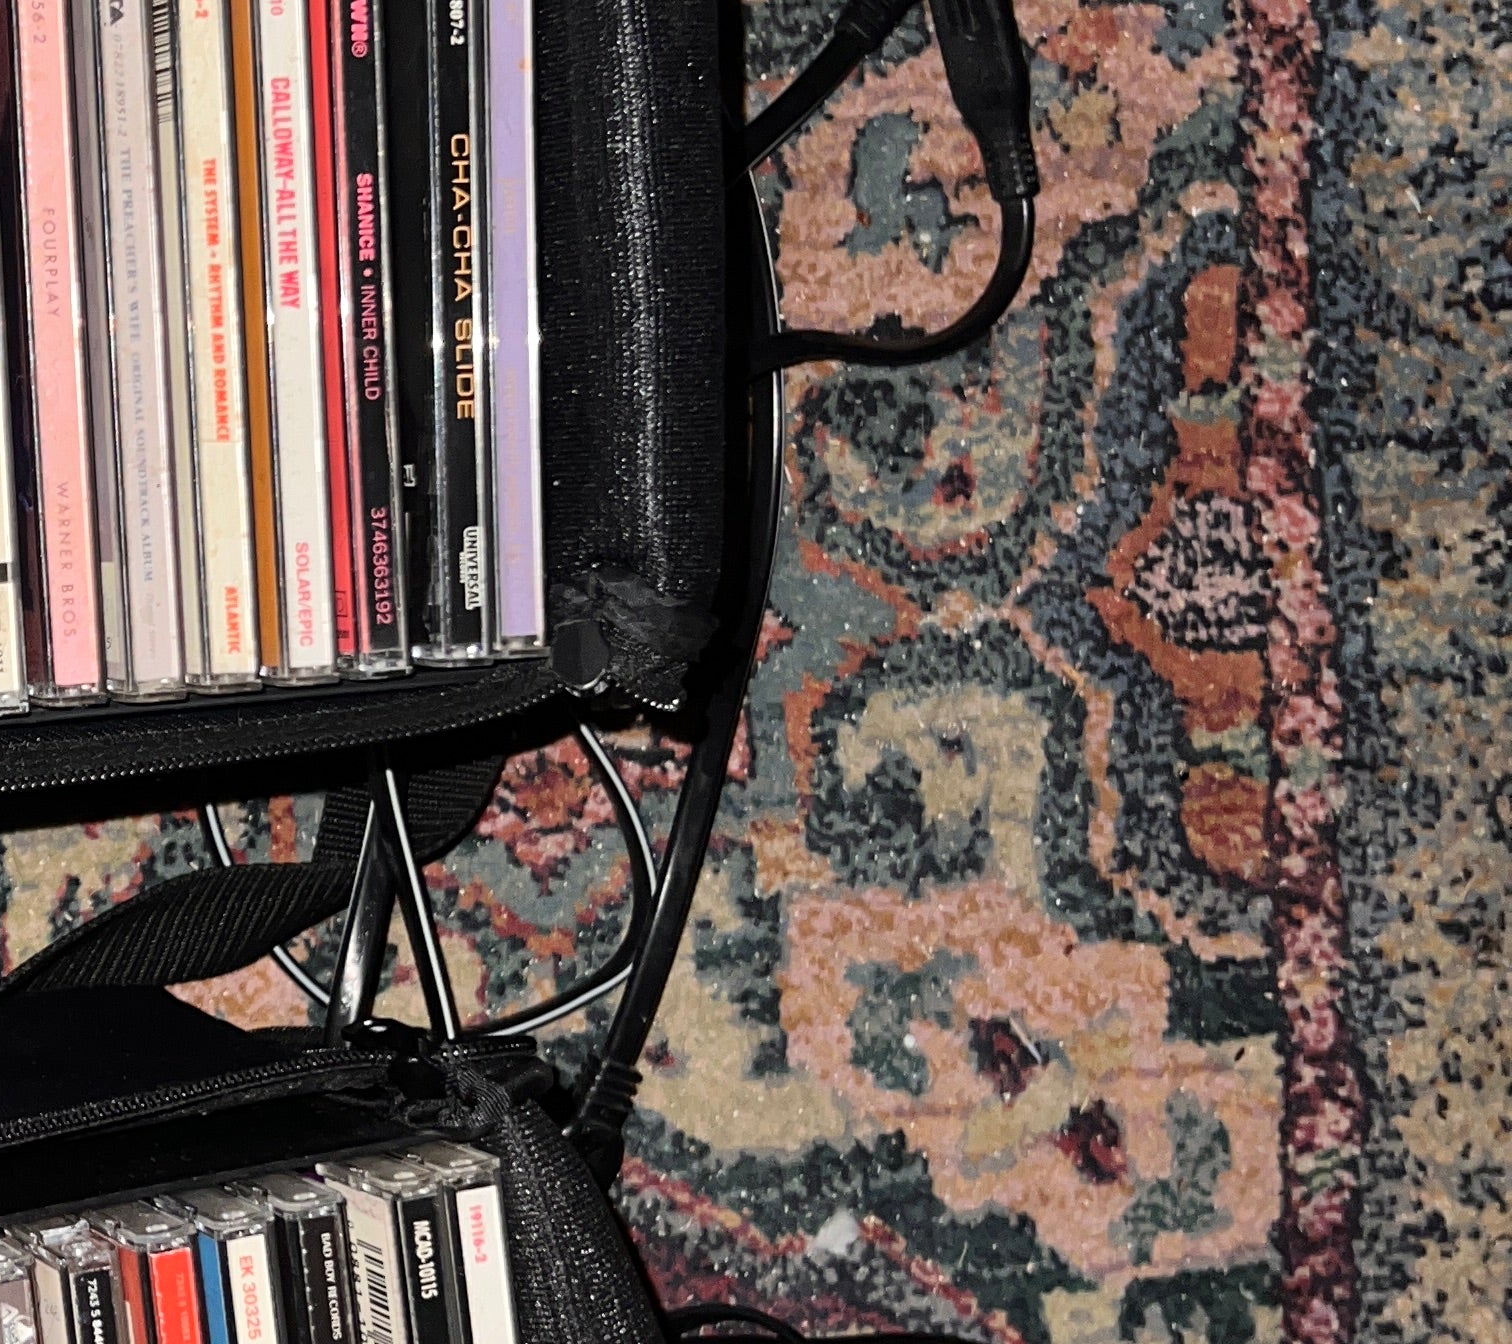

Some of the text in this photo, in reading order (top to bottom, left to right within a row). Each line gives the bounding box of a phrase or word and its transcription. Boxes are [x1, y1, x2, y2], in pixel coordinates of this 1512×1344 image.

[203, 157, 231, 442] THE SYSTEM RHYTHM AND ROMANCE
[356, 172, 382, 400] SHANICE INNER CHILD
[451, 133, 473, 420] CHA-CHA SLIDE
[295, 541, 315, 646] SOLAR/EPIC
